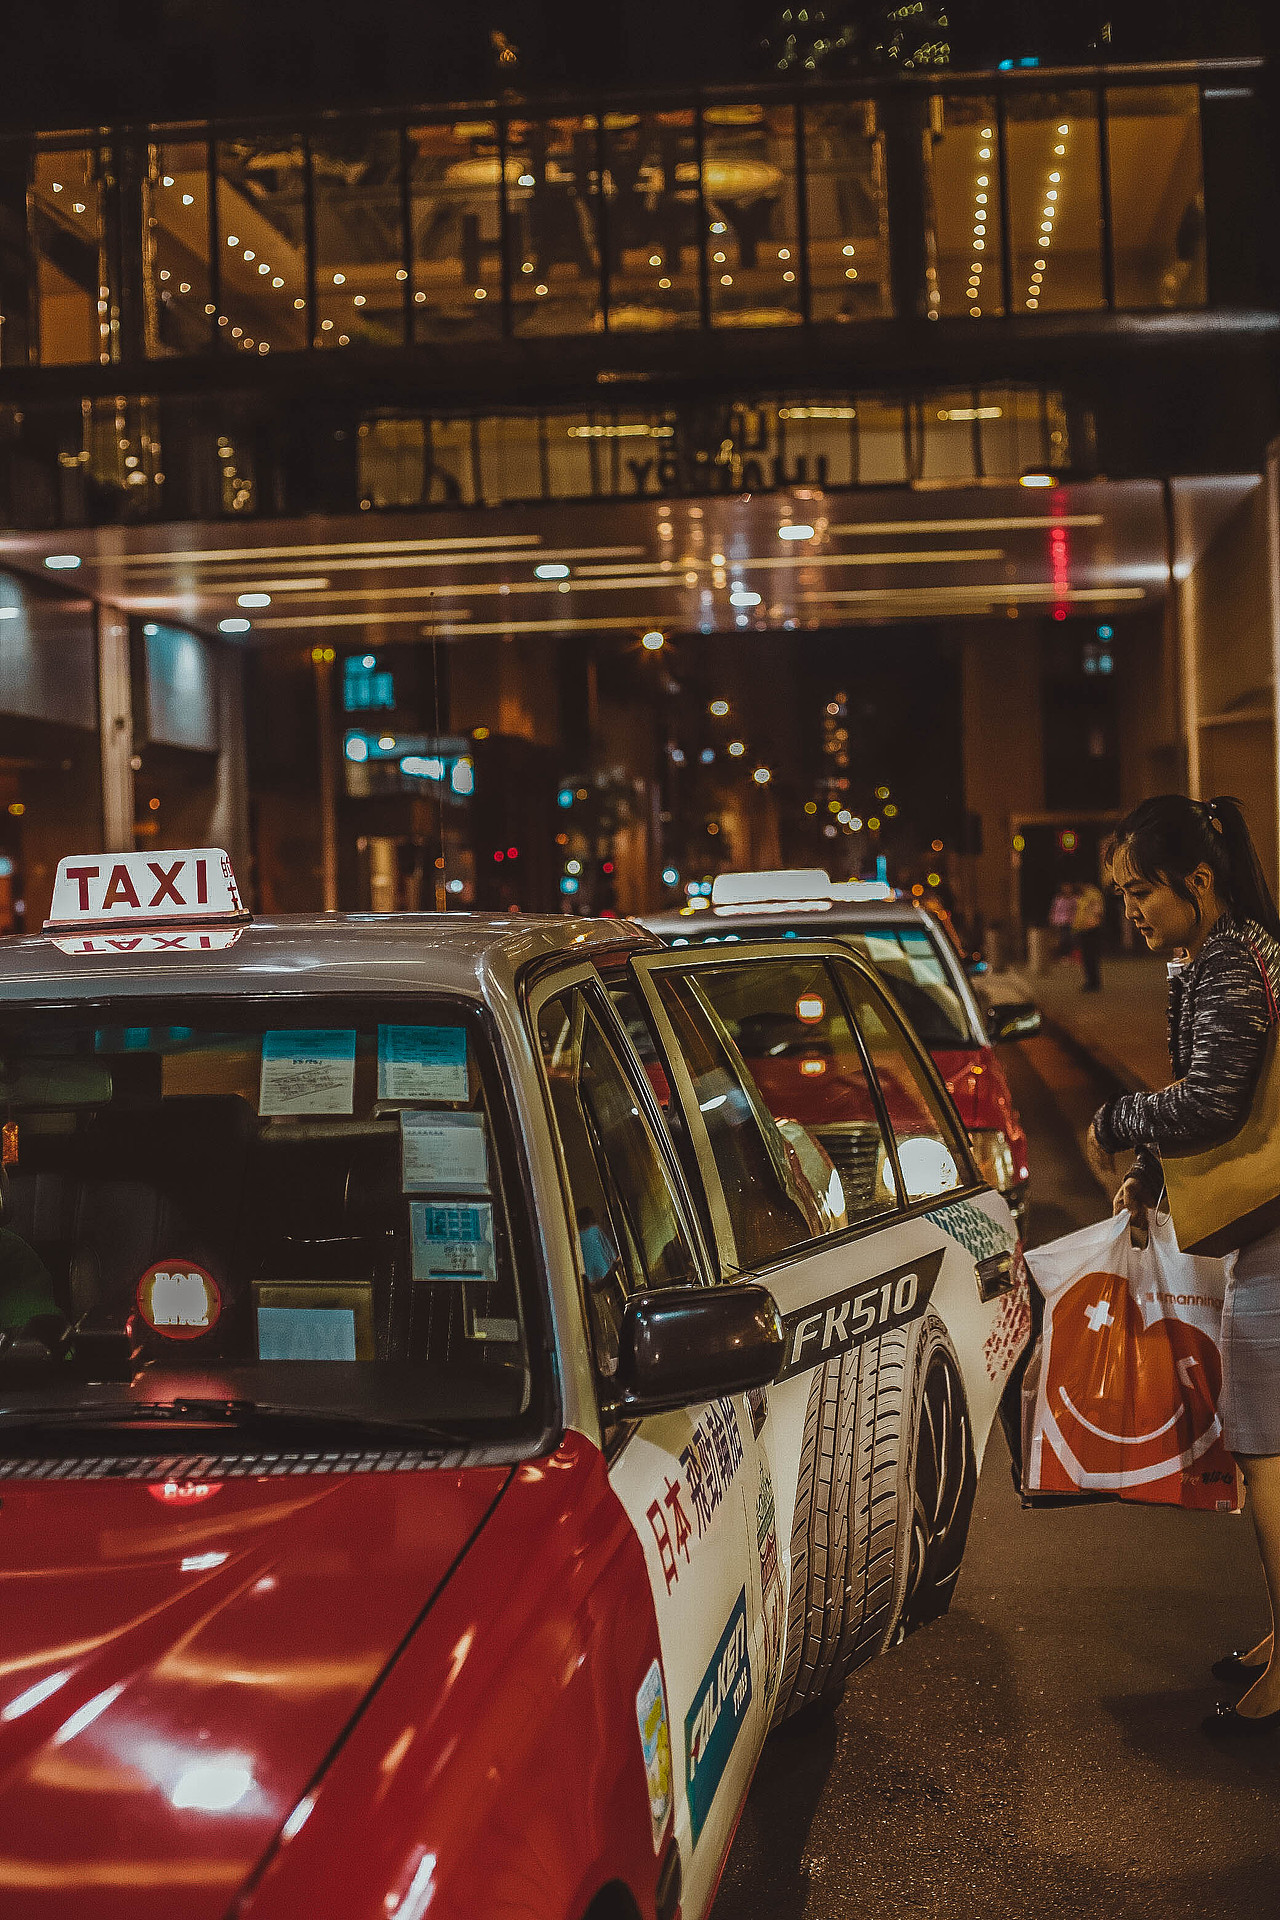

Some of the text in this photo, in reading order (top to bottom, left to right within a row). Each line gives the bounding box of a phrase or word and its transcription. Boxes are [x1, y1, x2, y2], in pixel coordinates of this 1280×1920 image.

[66, 859, 208, 911] TAXI
[221, 856, 241, 911] 的士
[790, 1273, 919, 1365] FK510
[646, 1476, 692, 1597] 日本
[691, 1612, 745, 1782] FALKEN
